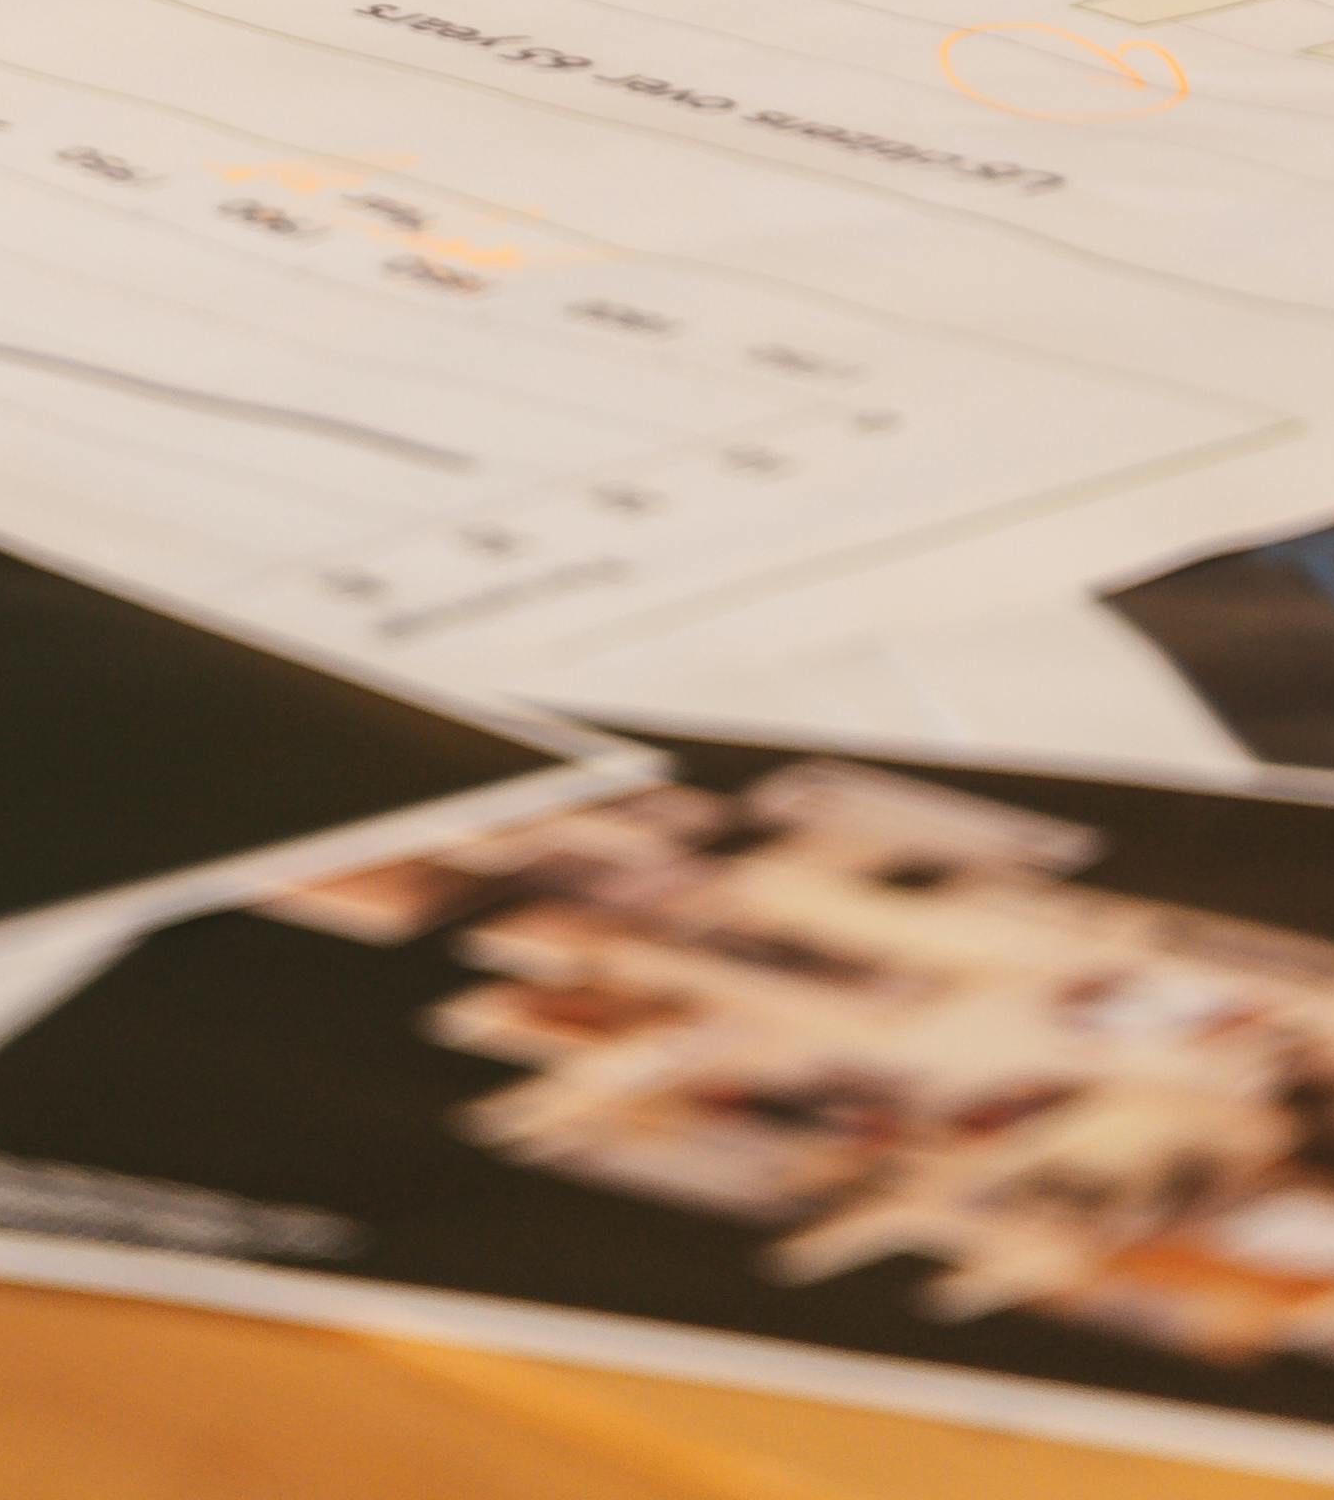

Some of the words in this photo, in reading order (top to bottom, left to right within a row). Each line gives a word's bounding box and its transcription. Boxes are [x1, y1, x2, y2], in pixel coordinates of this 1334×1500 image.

[352, 2, 531, 49] years
[495, 45, 592, 71] 65
[590, 72, 736, 115] over
